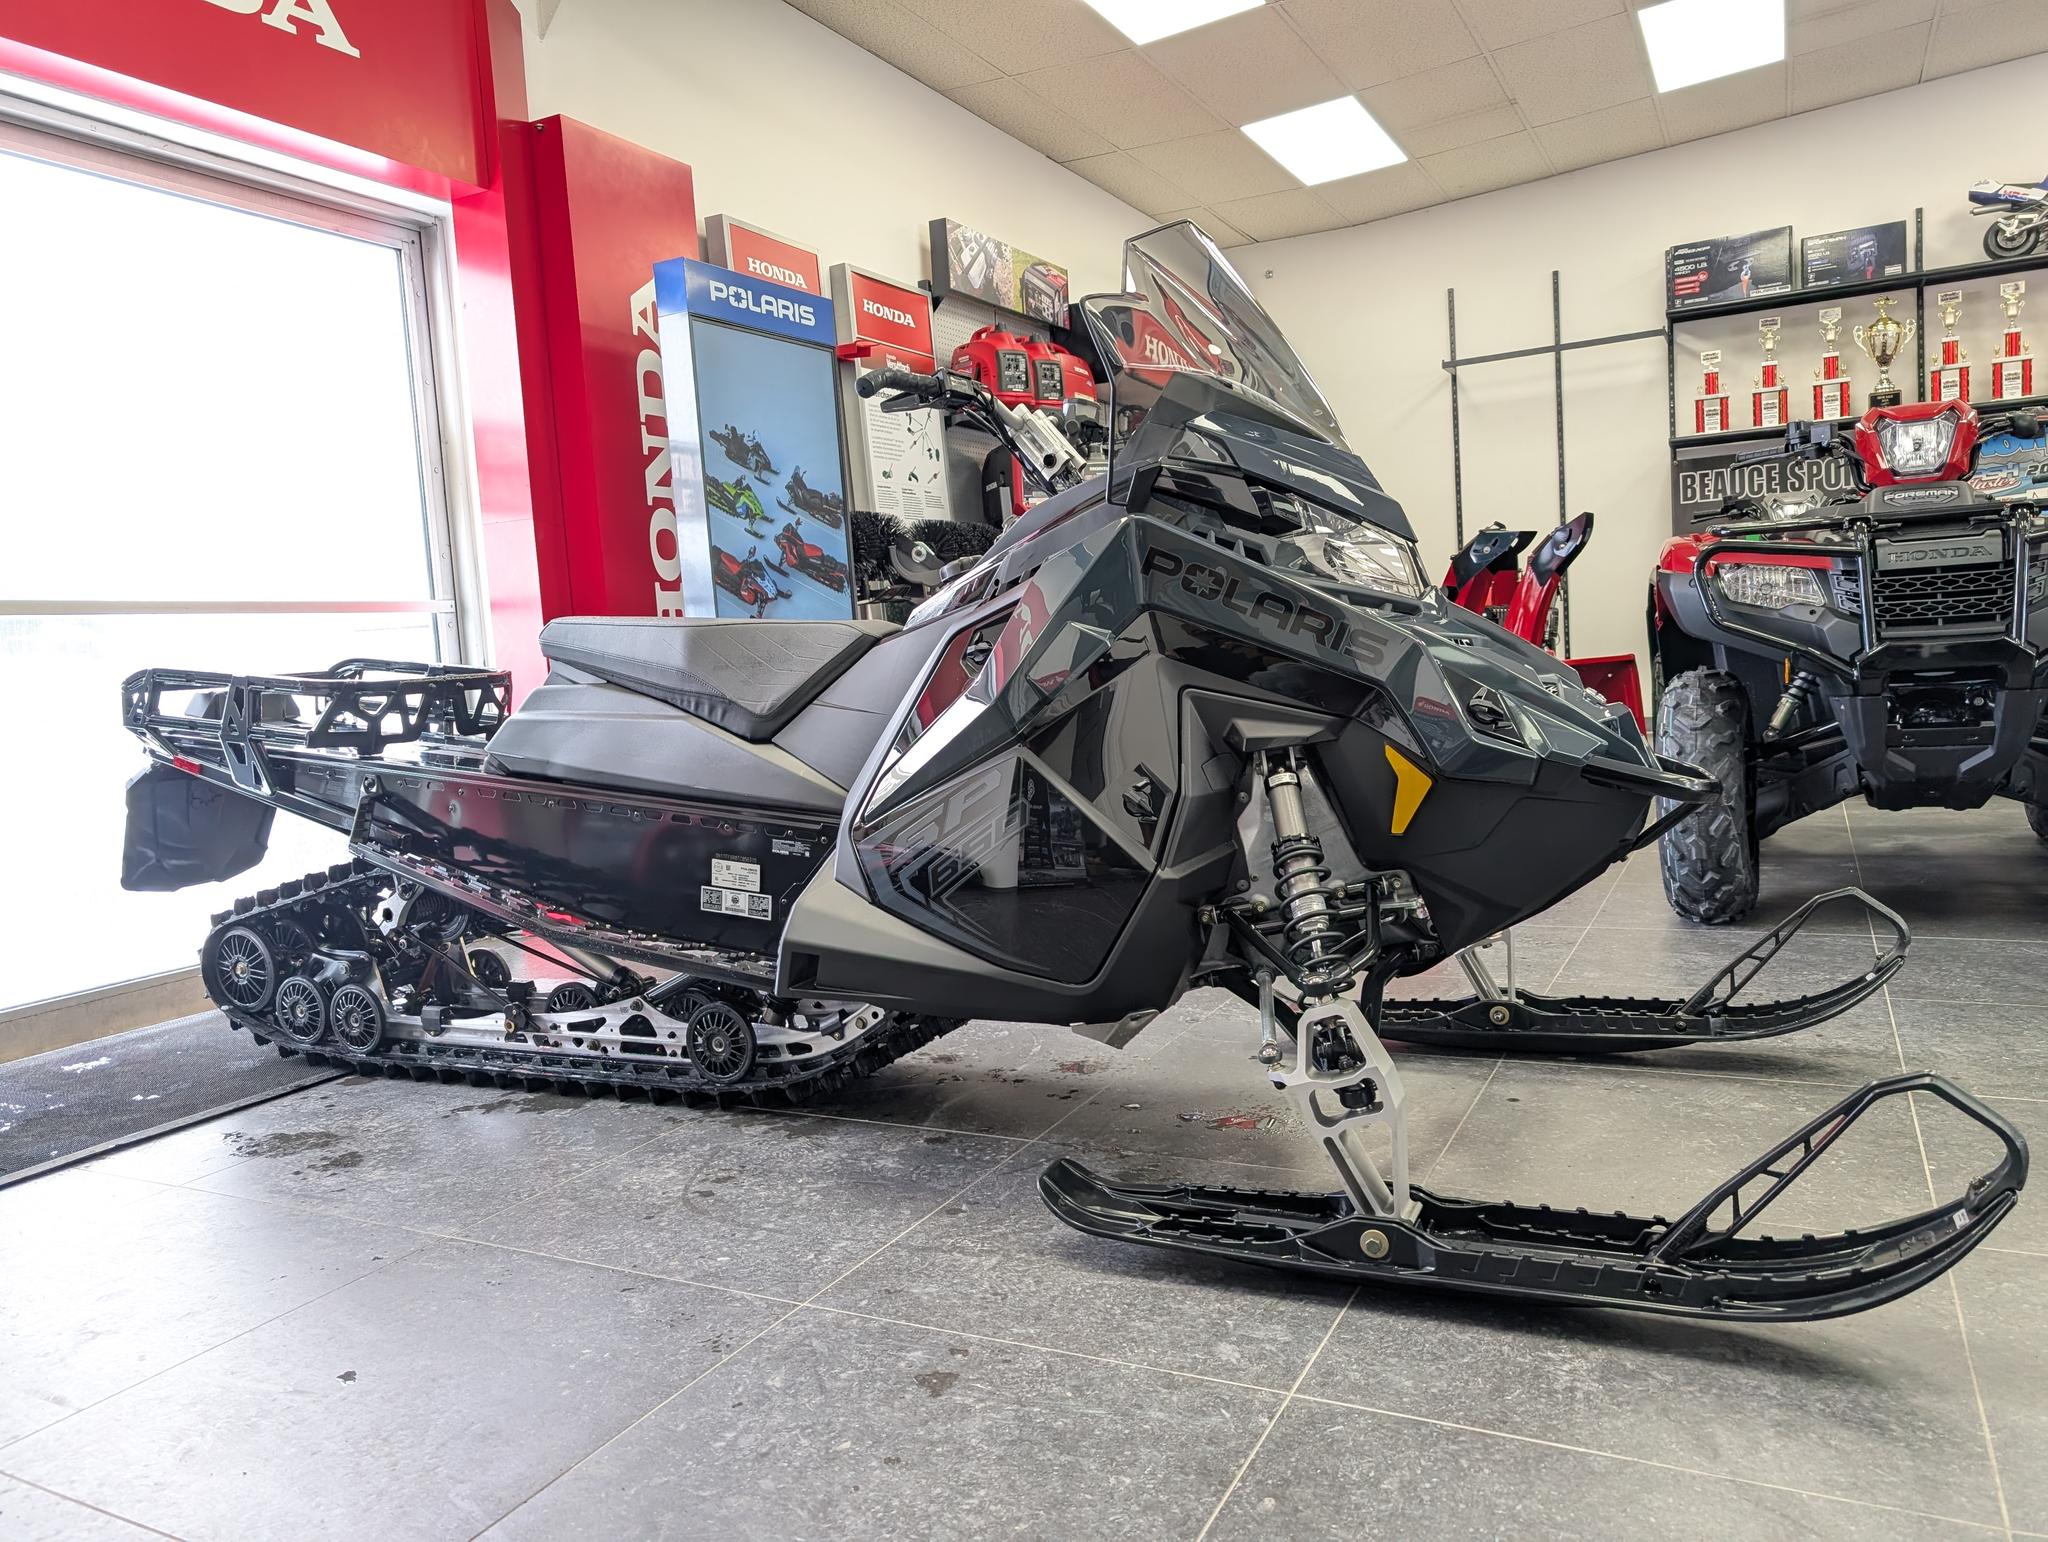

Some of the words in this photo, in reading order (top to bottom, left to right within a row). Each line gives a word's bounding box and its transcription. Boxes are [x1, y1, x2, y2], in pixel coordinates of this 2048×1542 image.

[747, 257, 808, 289] HONDA
[709, 280, 816, 327] POLARIS
[862, 298, 916, 328] HONDA
[1680, 463, 1780, 504] BEAUCE
[1883, 488, 1959, 501] FOREMAN
[1888, 545, 1992, 564] HONDA
[1140, 545, 1388, 666] POLARIS
